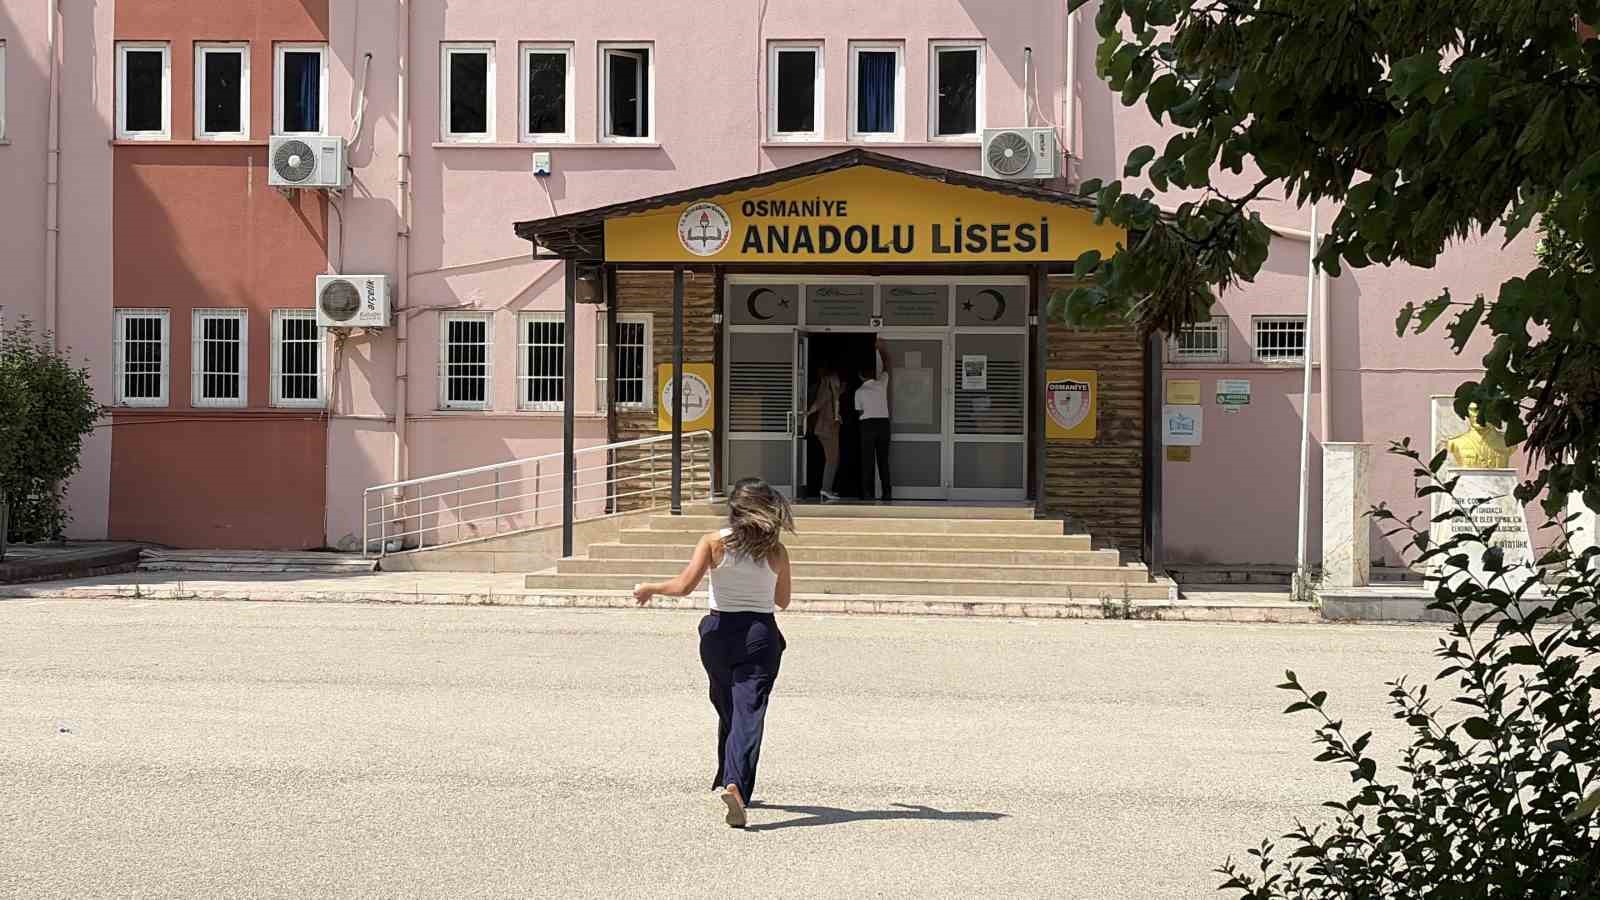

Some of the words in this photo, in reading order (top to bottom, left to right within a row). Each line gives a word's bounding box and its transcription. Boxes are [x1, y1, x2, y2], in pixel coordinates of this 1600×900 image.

[742, 196, 847, 217] OSMANİYE
[741, 224, 914, 254] ANADOLU
[932, 216, 1049, 253] LİSESİ
